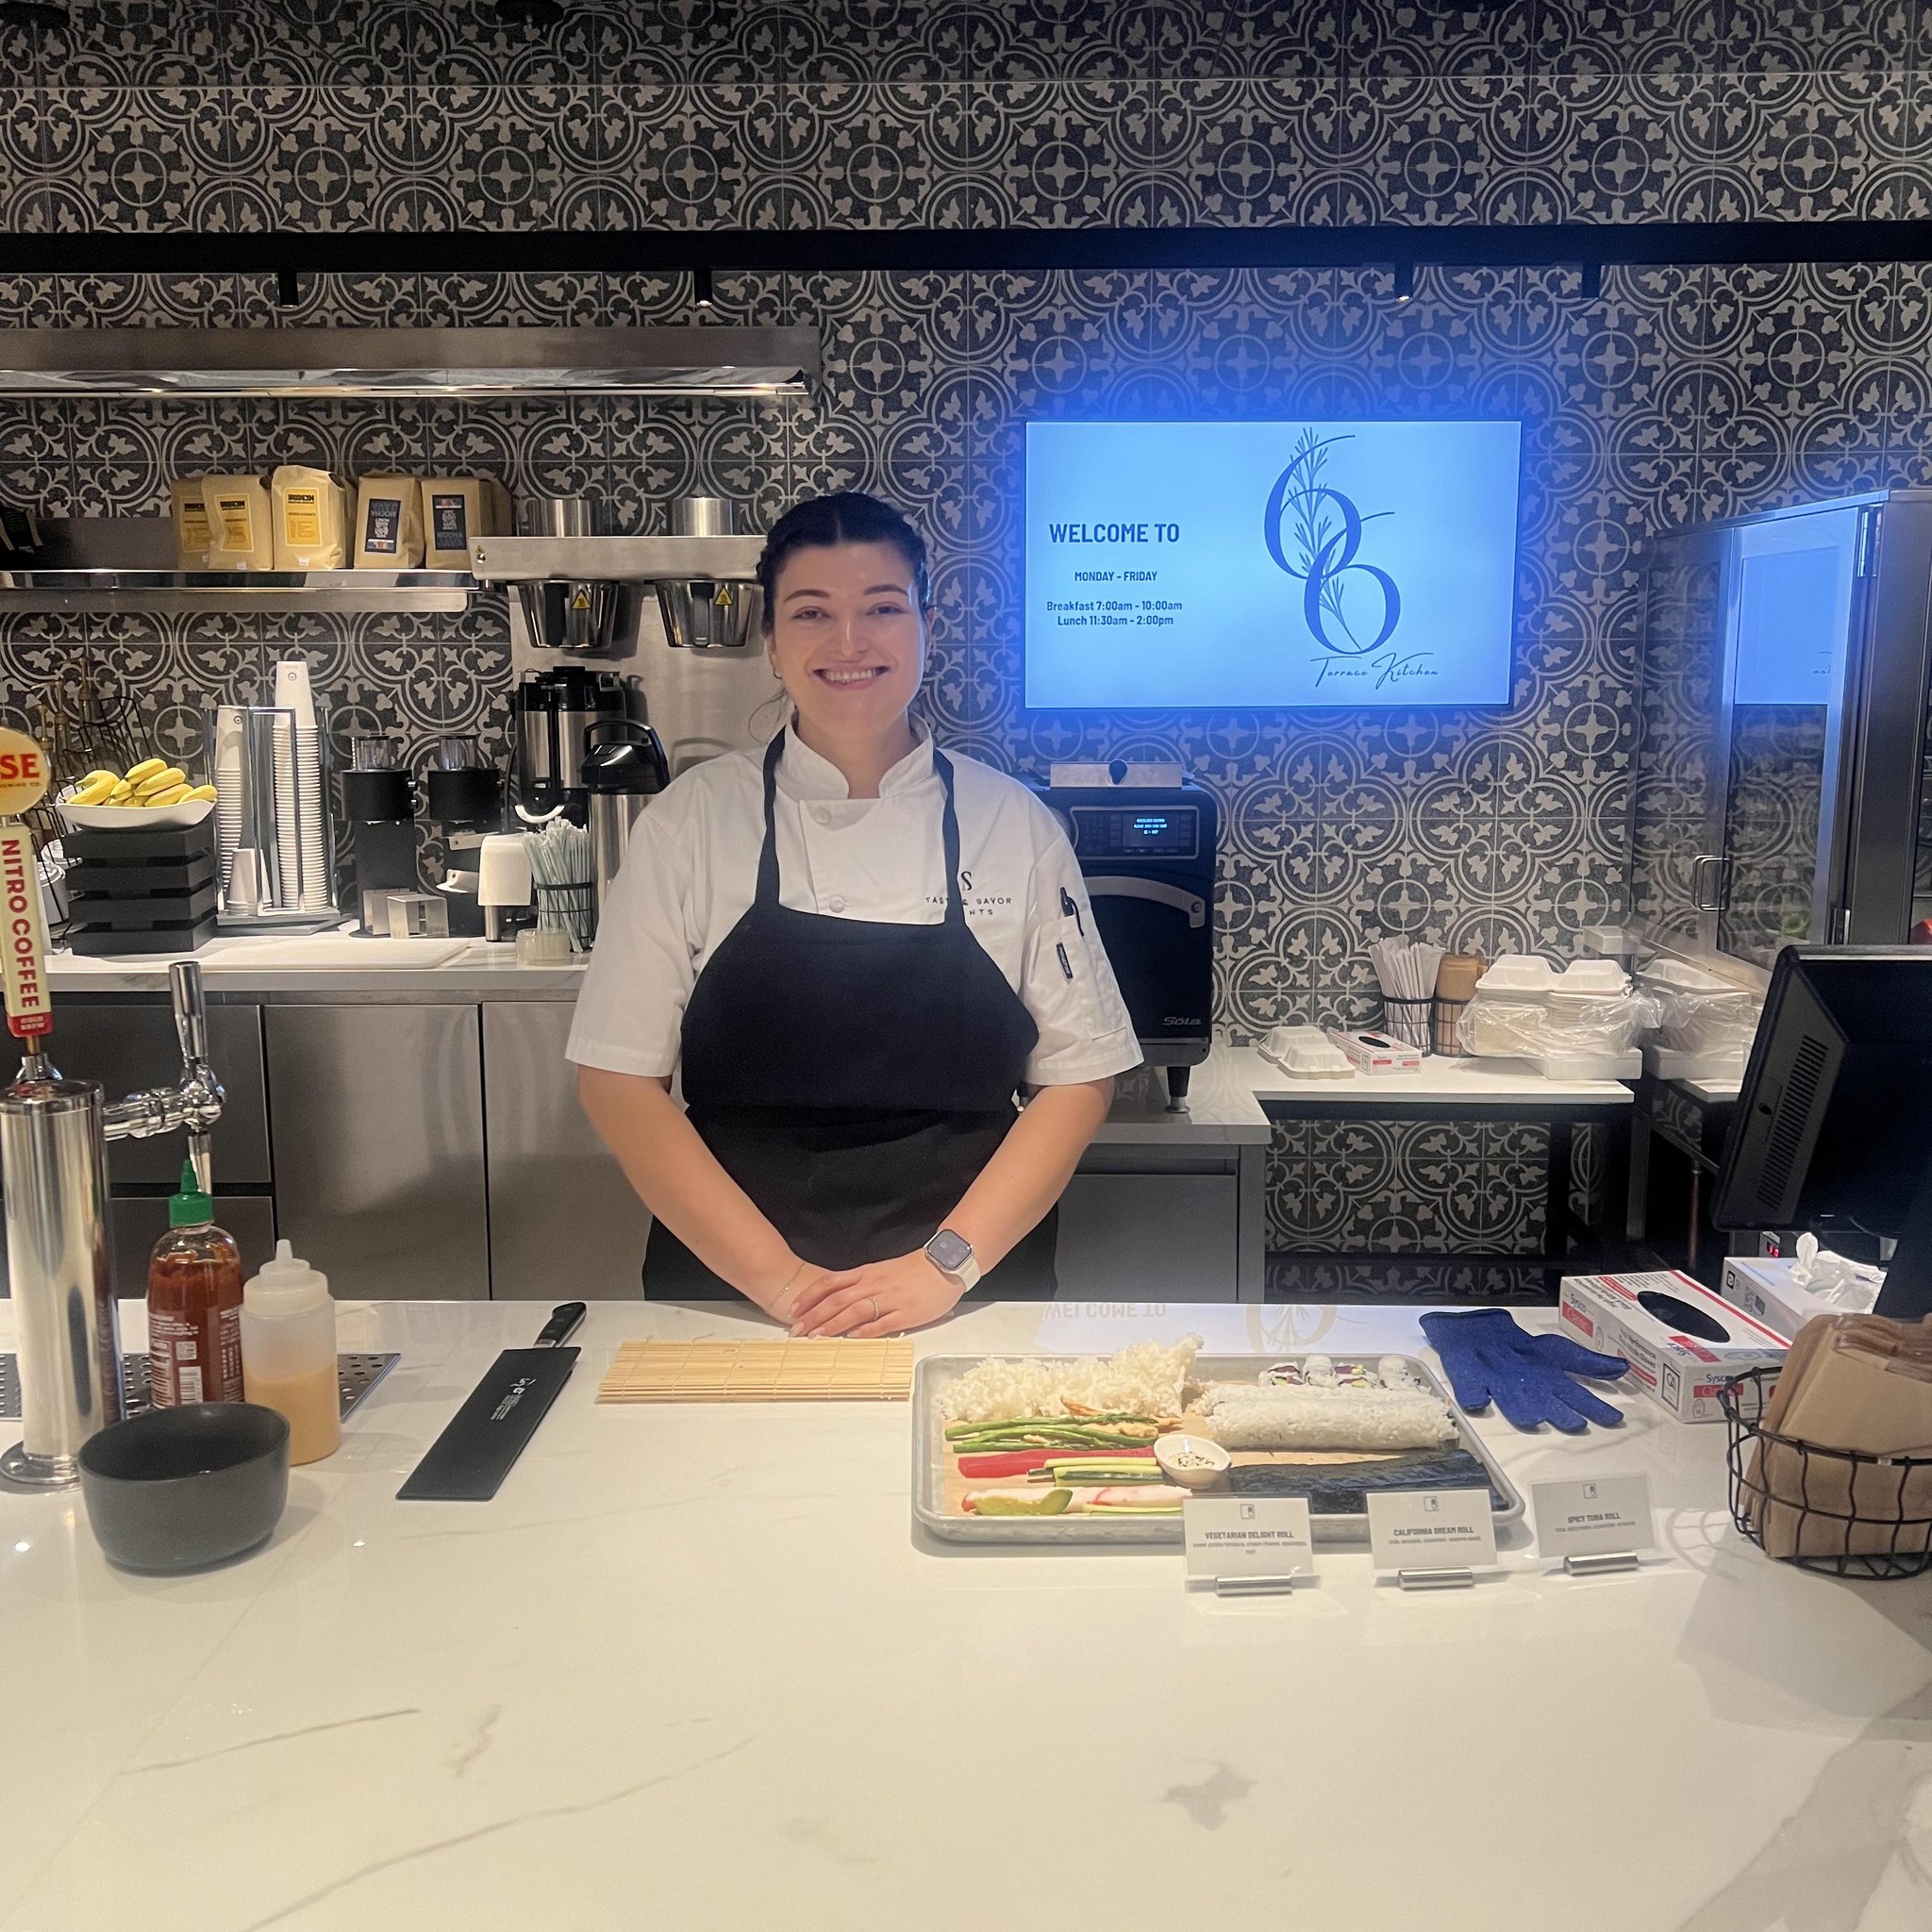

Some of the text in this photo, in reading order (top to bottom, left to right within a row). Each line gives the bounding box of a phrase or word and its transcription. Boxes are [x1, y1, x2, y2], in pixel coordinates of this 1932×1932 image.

[1049, 523, 1180, 543] WELCOME TO
[1074, 571, 1115, 582] MONDAY
[1124, 571, 1158, 581] FRIDAY
[1046, 601, 1094, 611] Breakfast
[1096, 601, 1133, 611] 7:00am
[1141, 600, 1183, 610] 10:00am
[1058, 615, 1088, 625] Lunch
[1090, 615, 1128, 625] 11:30am
[1136, 615, 1174, 626] 2:00pm
[1310, 652, 1440, 691] Terrace Kitchen
[925, 896, 950, 905] TAS
[1, 839, 40, 1008] NITRO COFFEE
[1570, 1292, 1587, 1313] Sysco
[1706, 1374, 1728, 1384] Sysc
[1568, 1515, 1586, 1524] SPICY
[1205, 1531, 1246, 1540] VEGETARIAN
[1393, 1525, 1474, 1537] CALIFORNIA DREAM ROLL
